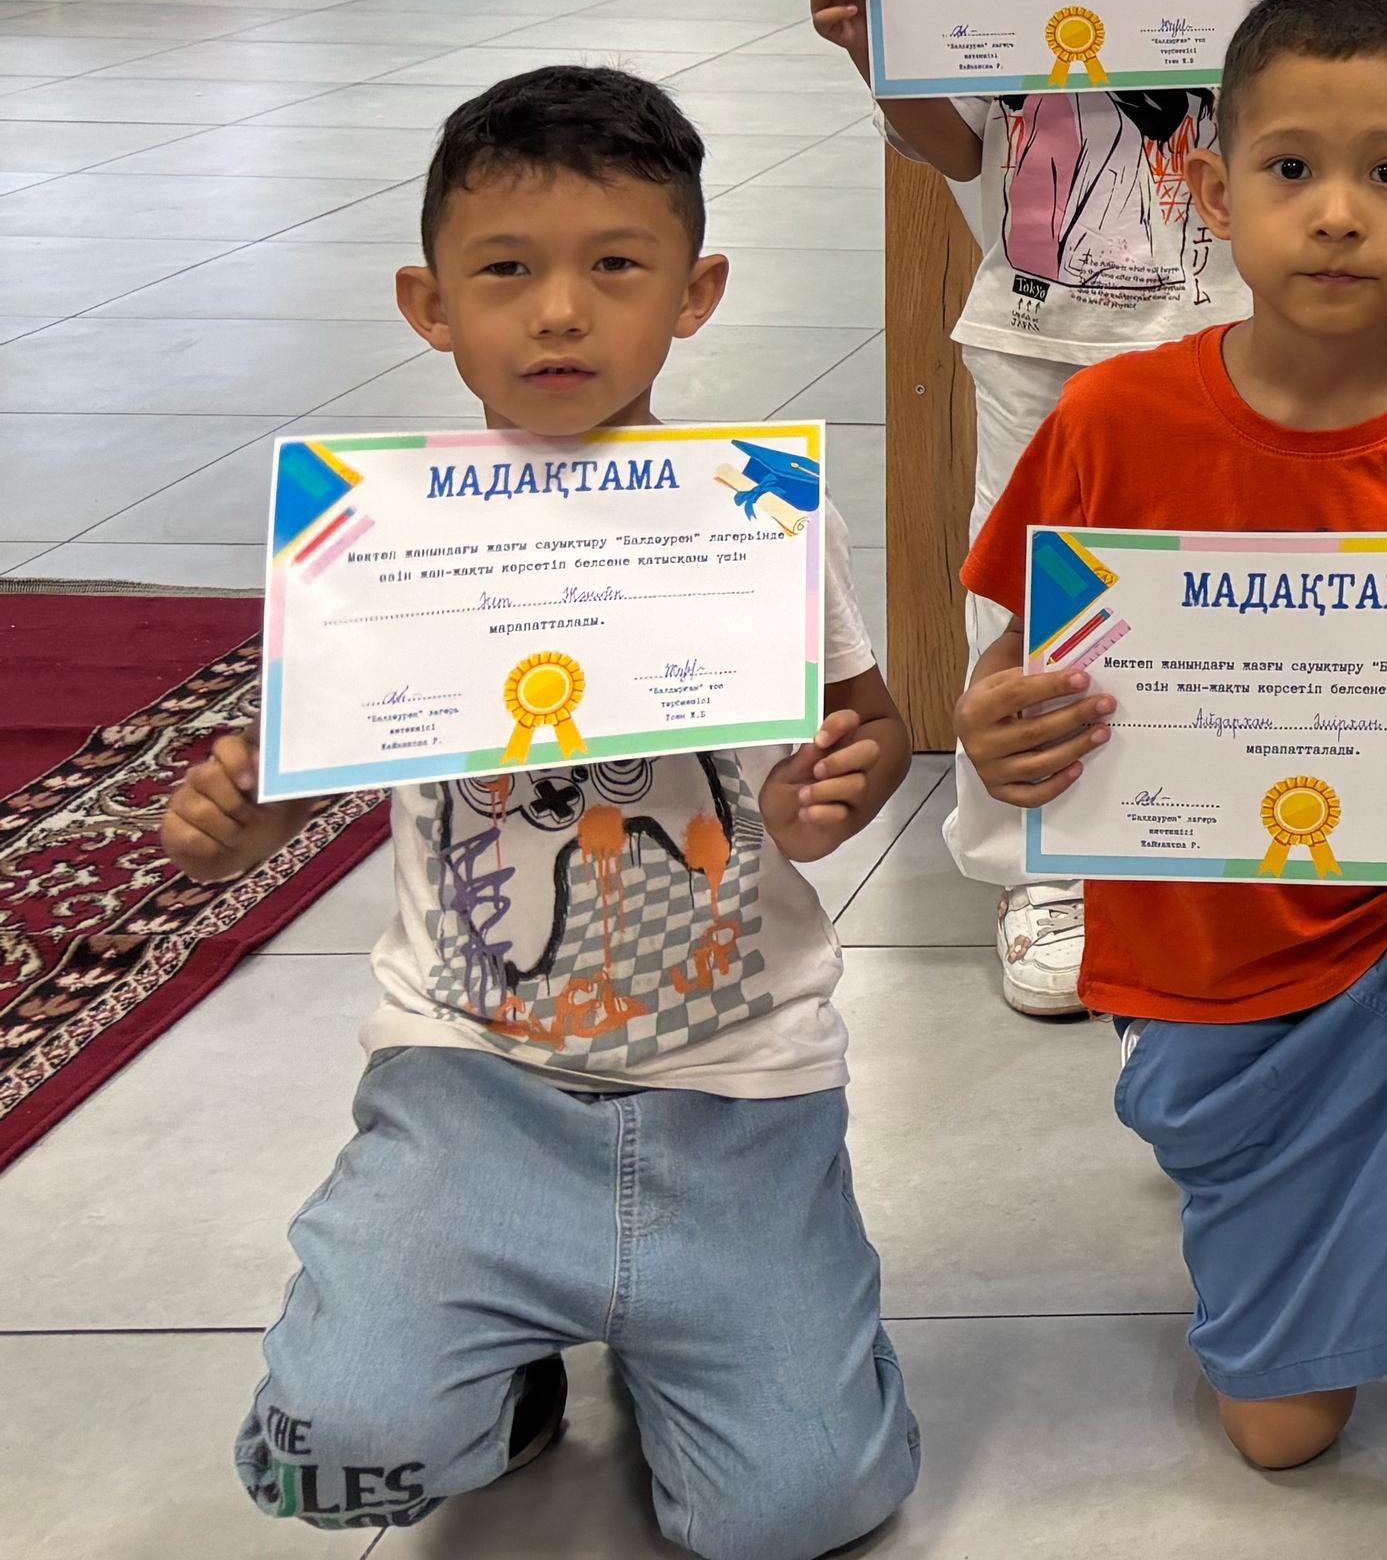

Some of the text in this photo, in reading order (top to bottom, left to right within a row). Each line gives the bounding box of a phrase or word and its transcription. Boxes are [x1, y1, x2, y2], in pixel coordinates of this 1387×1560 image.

[426, 458, 680, 502] МАДАҚТАМА
[489, 616, 605, 636] марапатталады.
[1103, 656, 1154, 670] Мектеп
[1161, 660, 1235, 671] жанындағы
[1242, 661, 1284, 672] жазғы
[1290, 662, 1364, 676] сауықтыру
[1136, 680, 1169, 692] өзін
[1176, 683, 1250, 695] жан-жақты
[1257, 682, 1323, 697] көрсетіп
[1330, 683, 1387, 695] белсене
[1246, 745, 1361, 757] марапатталады.
